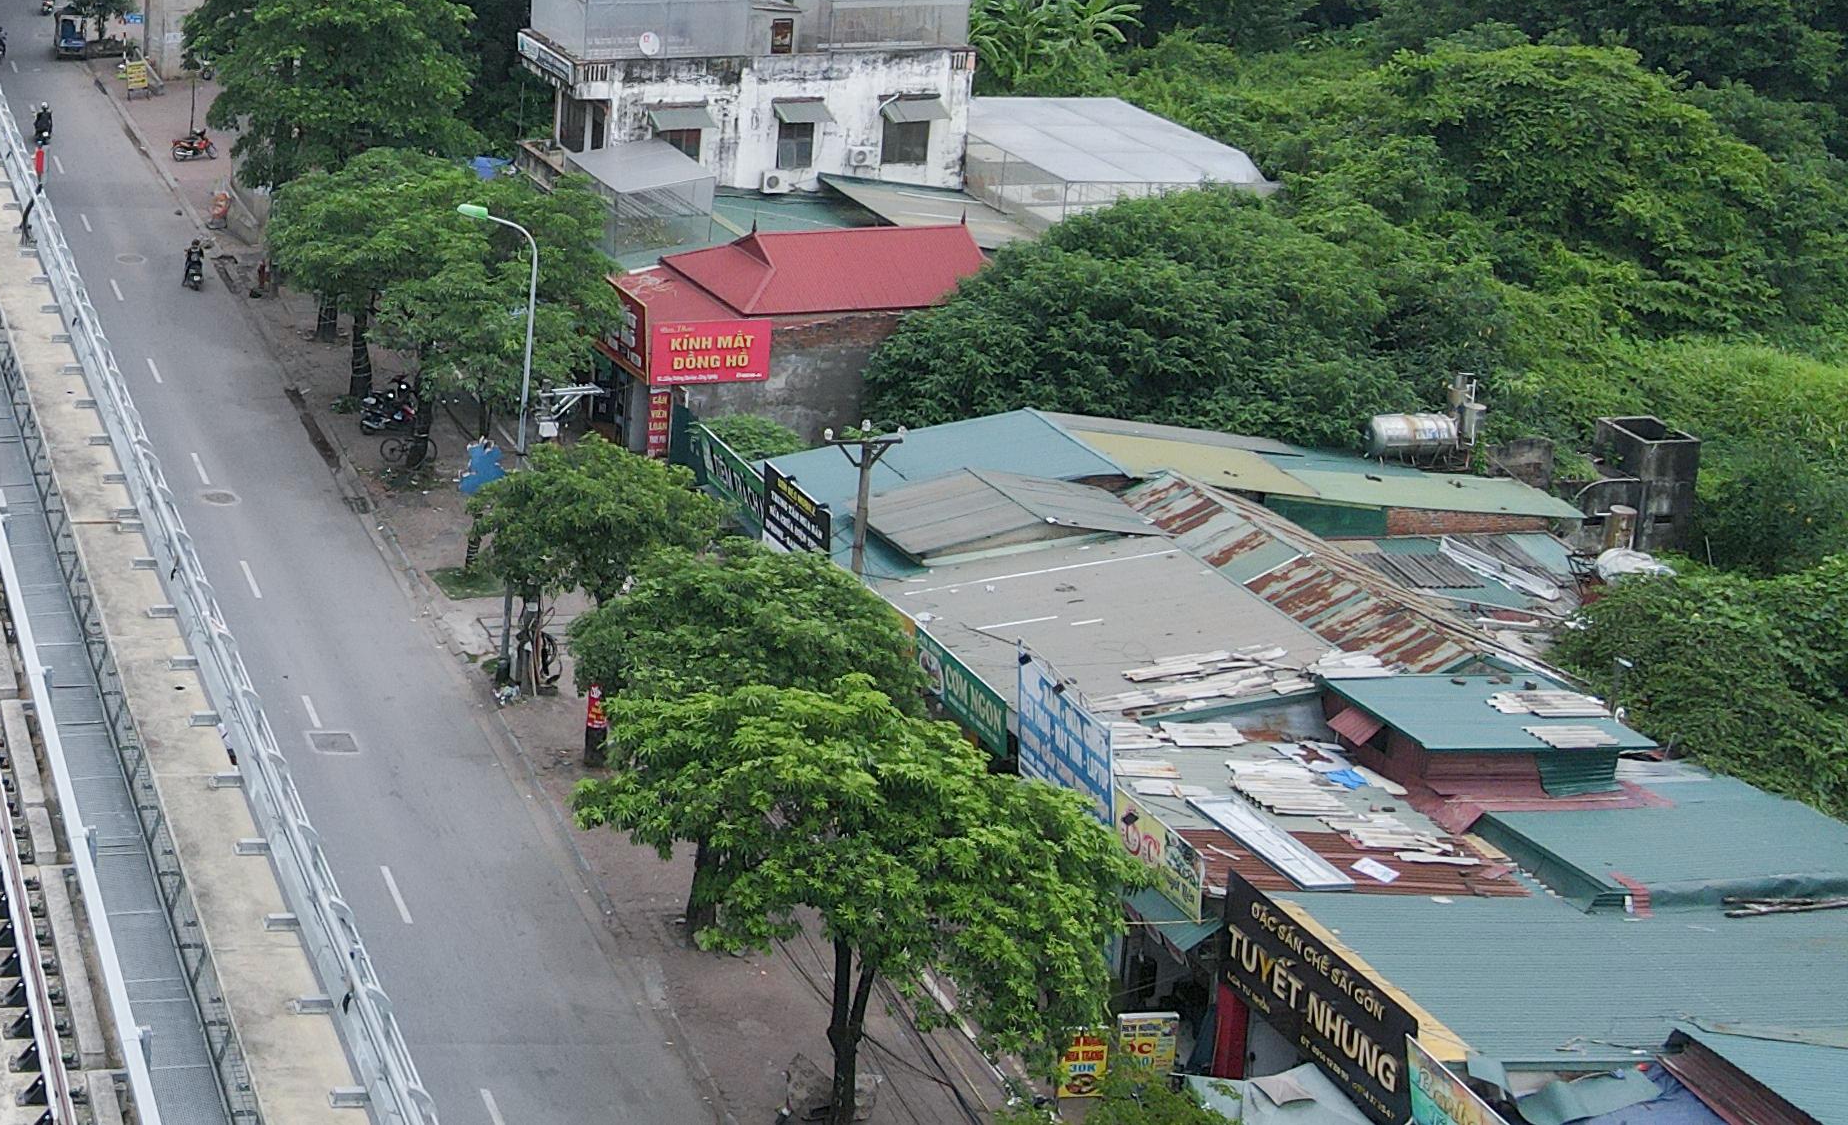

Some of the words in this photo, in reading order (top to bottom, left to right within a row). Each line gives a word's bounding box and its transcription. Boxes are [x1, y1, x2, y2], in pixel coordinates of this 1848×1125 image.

[670, 333, 713, 352] KÍNH
[717, 330, 755, 350] MẮT
[672, 350, 721, 371] ĐỒNG
[725, 348, 749, 368] HỒ
[970, 683, 1002, 734] NGON
[1251, 901, 1276, 932] ĐẶC
[1303, 945, 1329, 976] CHÈ
[1331, 969, 1352, 996] SÀI
[1354, 988, 1385, 1021] GÒN
[1228, 923, 1304, 1010] TUYẾT
[1307, 990, 1400, 1093] NHUNG
[1070, 1063, 1097, 1073] 30K
